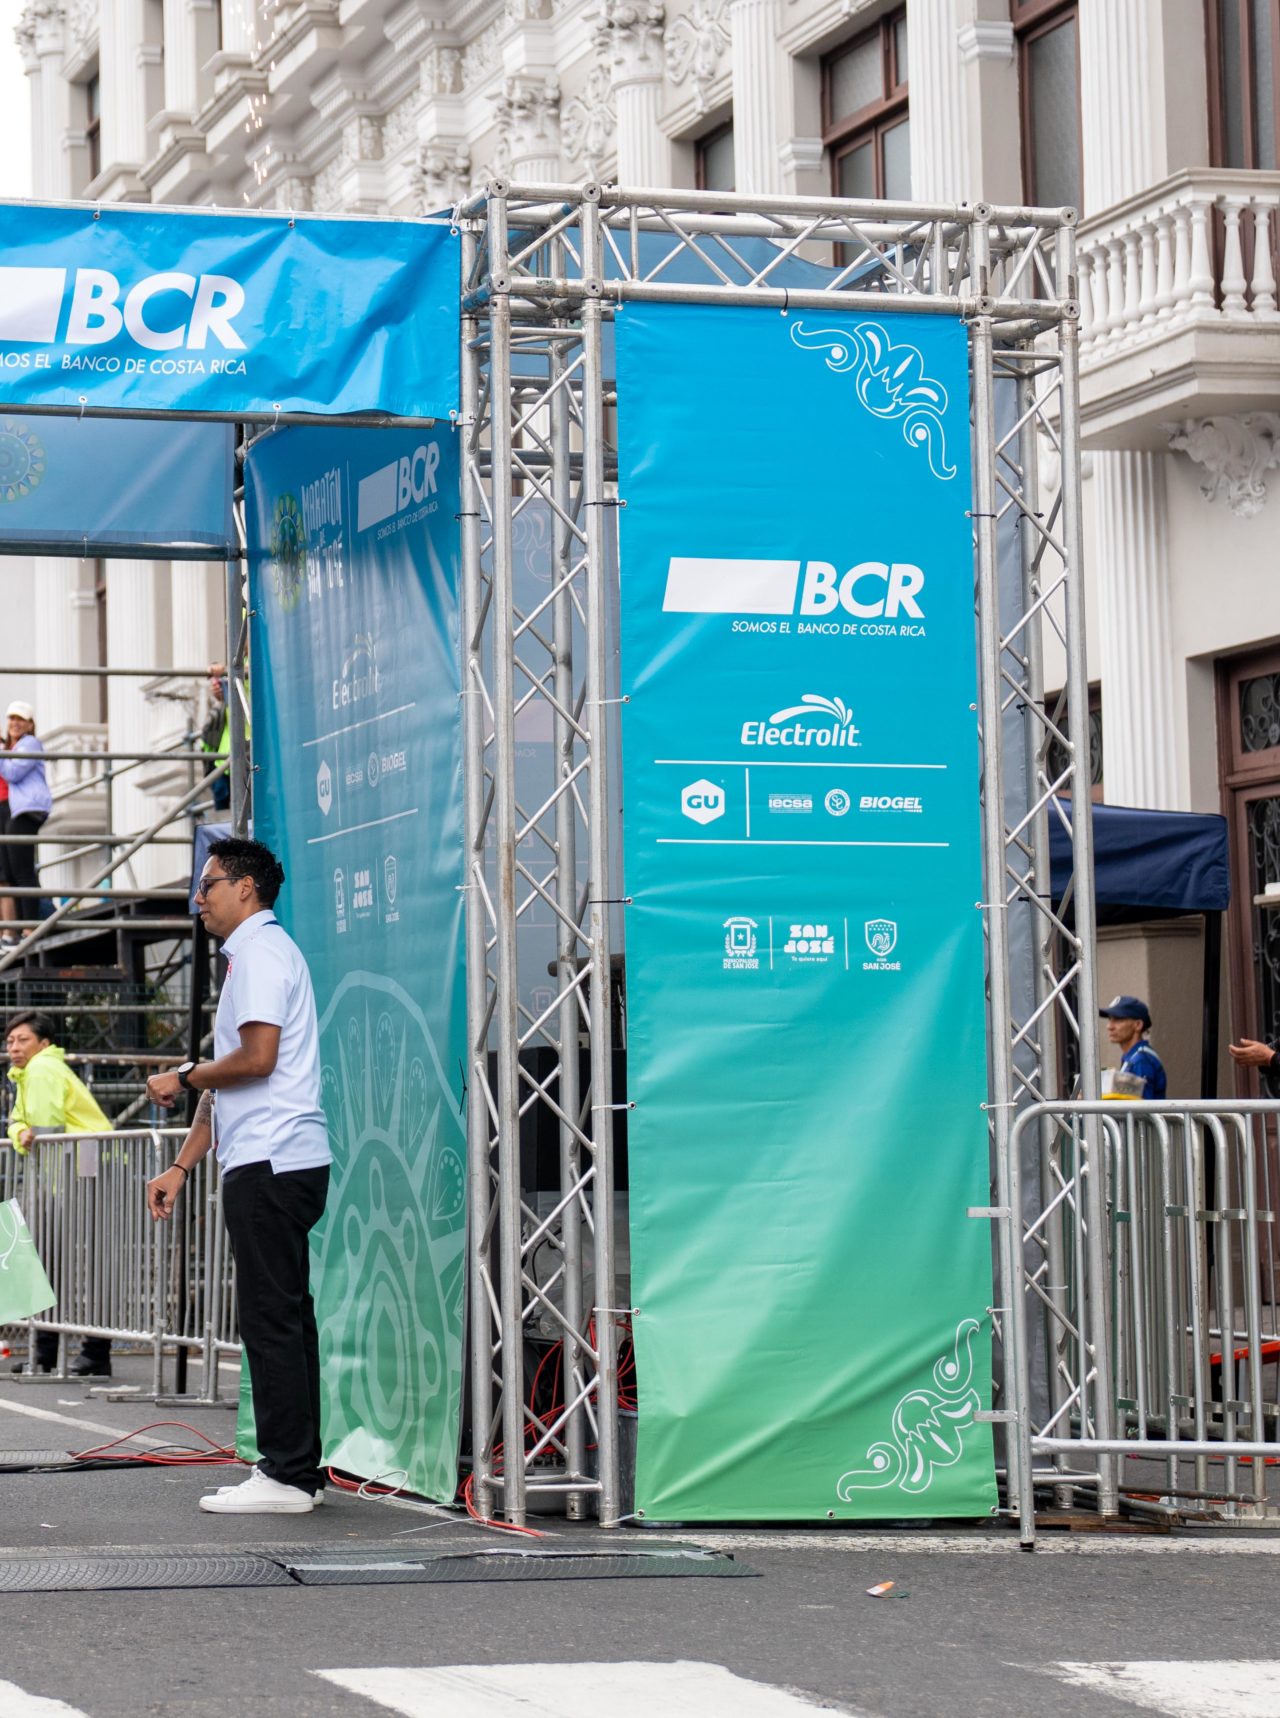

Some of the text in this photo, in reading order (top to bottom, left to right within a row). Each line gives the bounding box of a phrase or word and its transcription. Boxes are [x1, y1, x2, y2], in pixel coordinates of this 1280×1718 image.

[65, 268, 247, 350] BCR
[34, 354, 52, 369] EL
[61, 354, 120, 373] BANCO
[124, 358, 146, 374] DE
[149, 359, 206, 374] COSTA
[210, 359, 248, 376] RICA
[398, 441, 440, 512] BCR
[301, 466, 342, 543] MARATÓN
[799, 560, 926, 618] BCR
[731, 620, 926, 637] SOMOS EL BANCO DE COSTA RICA
[740, 720, 860, 747] Electrolit
[381, 751, 406, 773] BIOGEL
[320, 779, 330, 798] GU
[686, 794, 719, 809] GU
[859, 796, 923, 809] BIOGEL
[790, 924, 828, 938] SAN
[783, 936, 835, 954] JOSÉ
[862, 960, 901, 971] SAN JOSÉ
